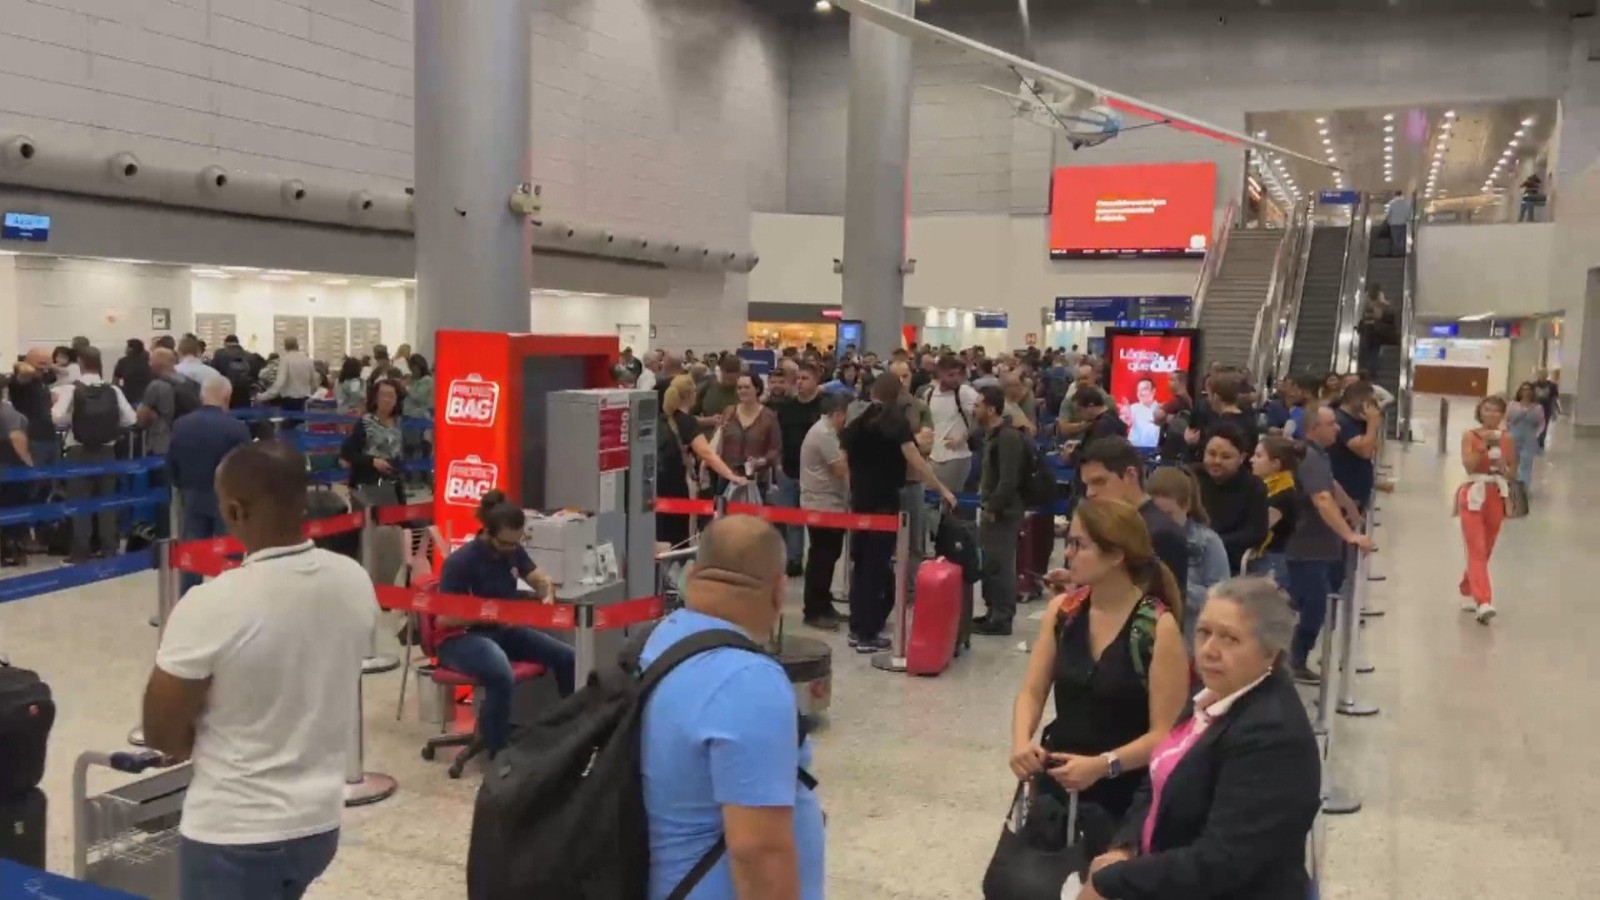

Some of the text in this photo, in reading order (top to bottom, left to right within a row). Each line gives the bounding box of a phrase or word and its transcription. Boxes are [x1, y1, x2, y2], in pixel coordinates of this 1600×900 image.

[1127, 361, 1151, 373] que
[449, 396, 493, 421] BAG
[448, 477, 491, 501] BAG
